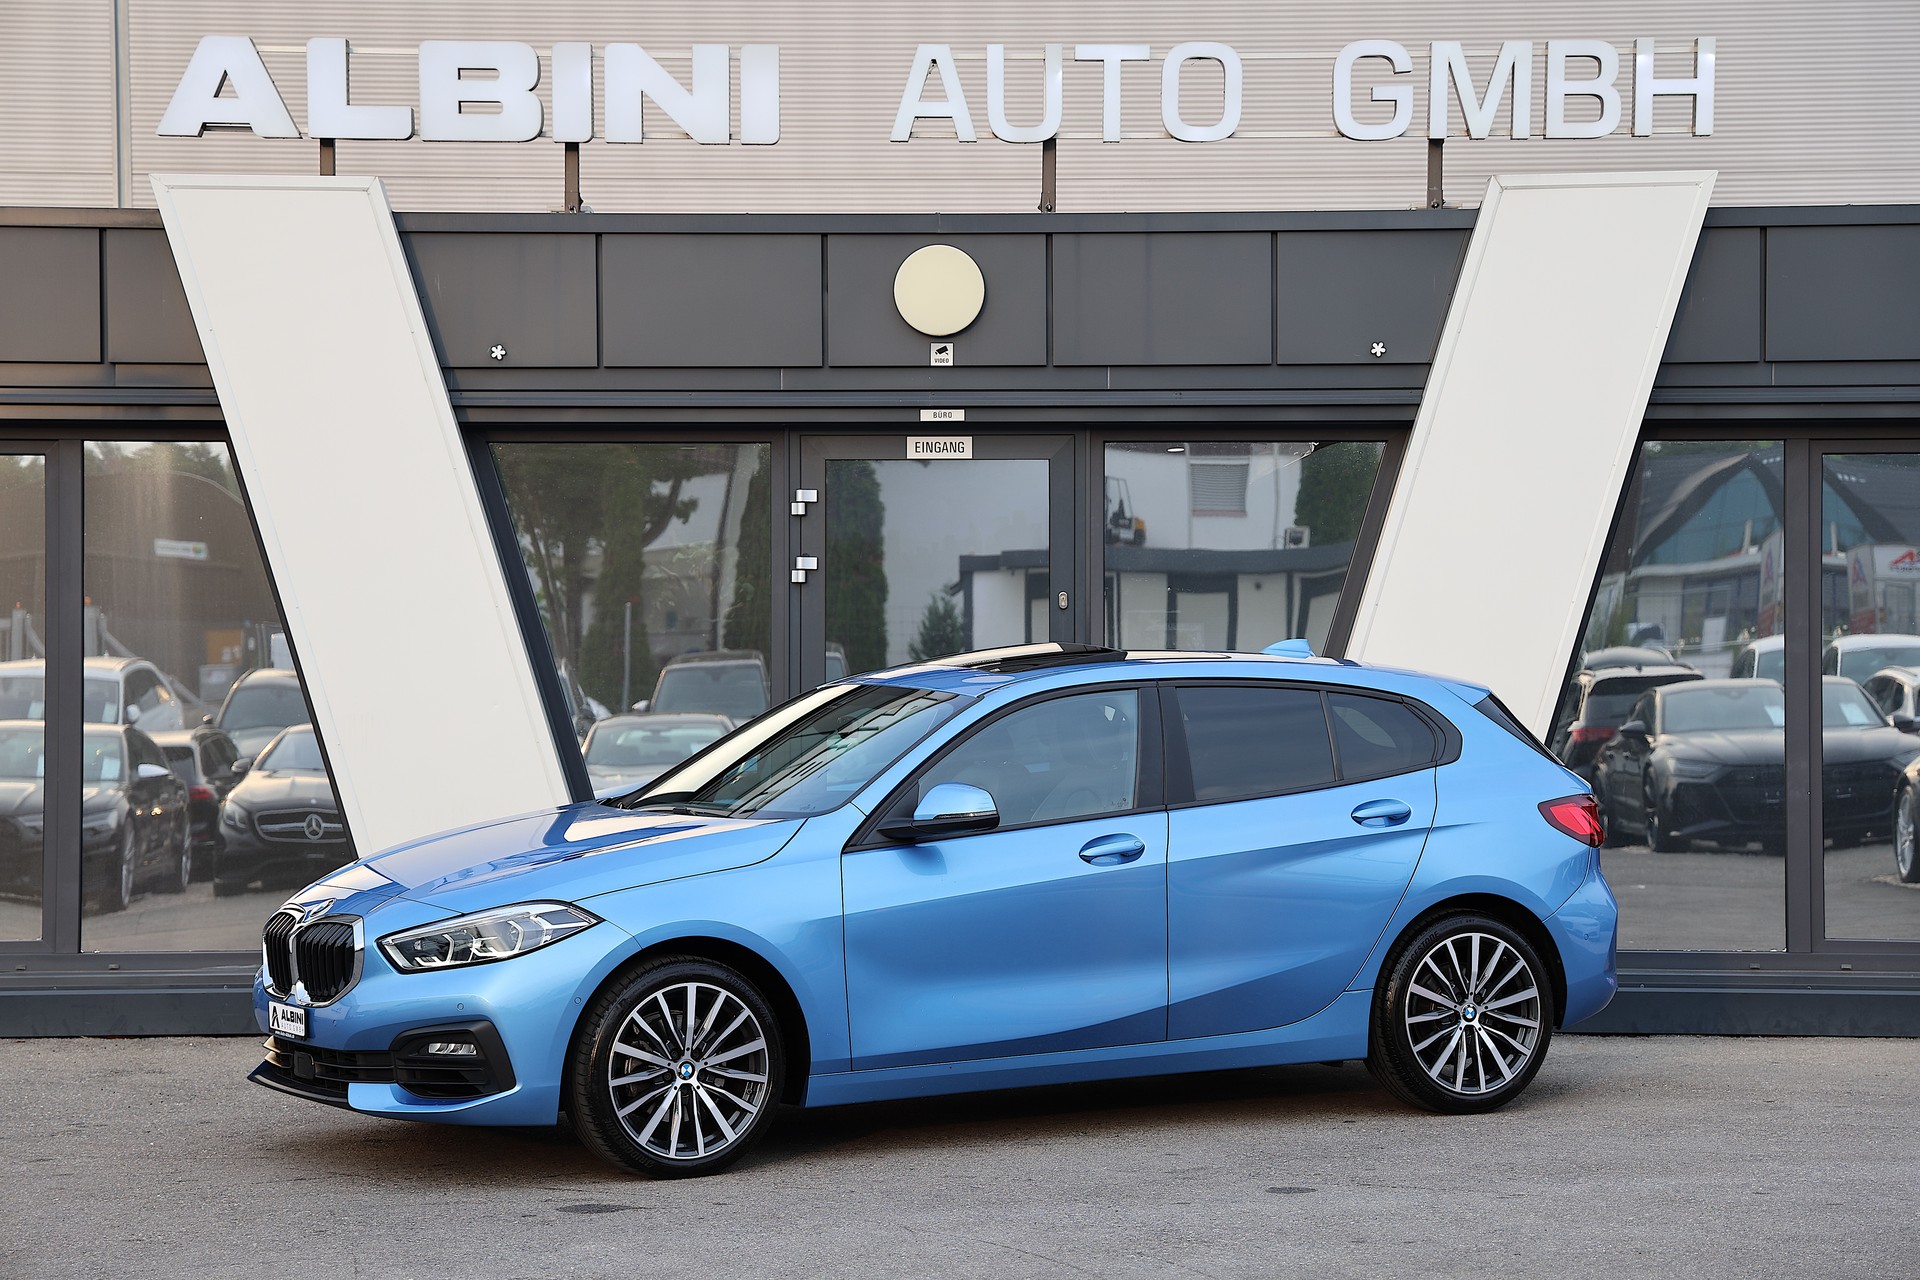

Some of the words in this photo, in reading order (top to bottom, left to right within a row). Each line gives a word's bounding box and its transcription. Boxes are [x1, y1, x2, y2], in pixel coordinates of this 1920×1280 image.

[156, 35, 780, 145] ALBINI
[889, 41, 1243, 144] AUTO
[1332, 36, 1717, 141] GMBH
[932, 411, 953, 419] BÜRO
[914, 441, 965, 454] EINGANG
[281, 1008, 304, 1026] ALBINI
